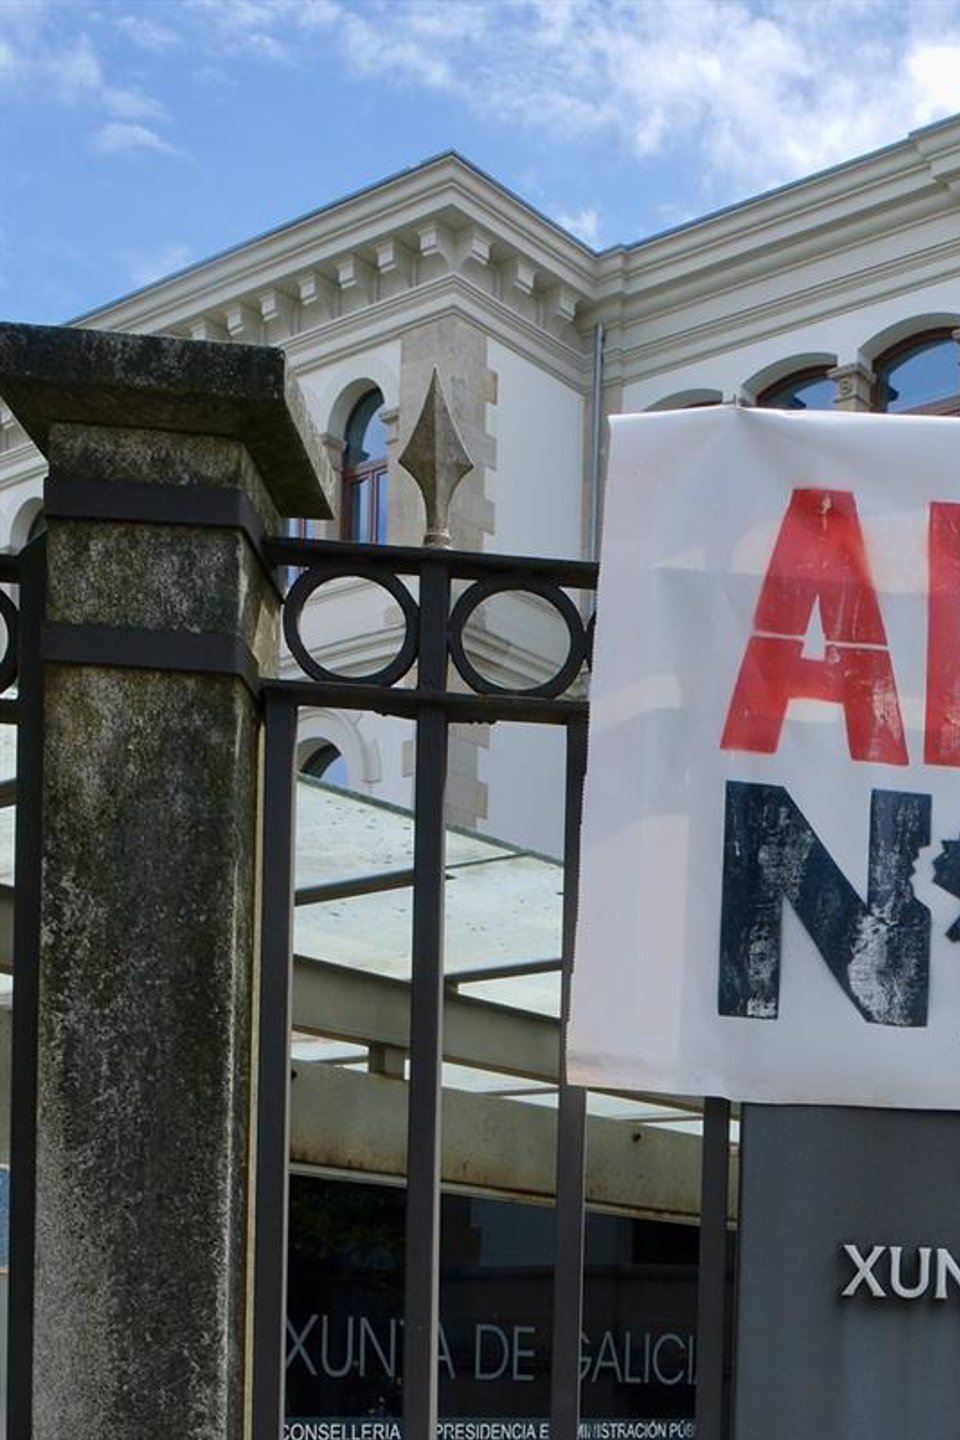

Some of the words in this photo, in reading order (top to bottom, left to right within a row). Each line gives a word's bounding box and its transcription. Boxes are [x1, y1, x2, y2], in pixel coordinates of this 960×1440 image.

[286, 1314, 456, 1379] XUNA
[474, 1324, 536, 1381] DE
[436, 1422, 537, 1440] PRESIDENCIA
[538, 1422, 550, 1440] E
